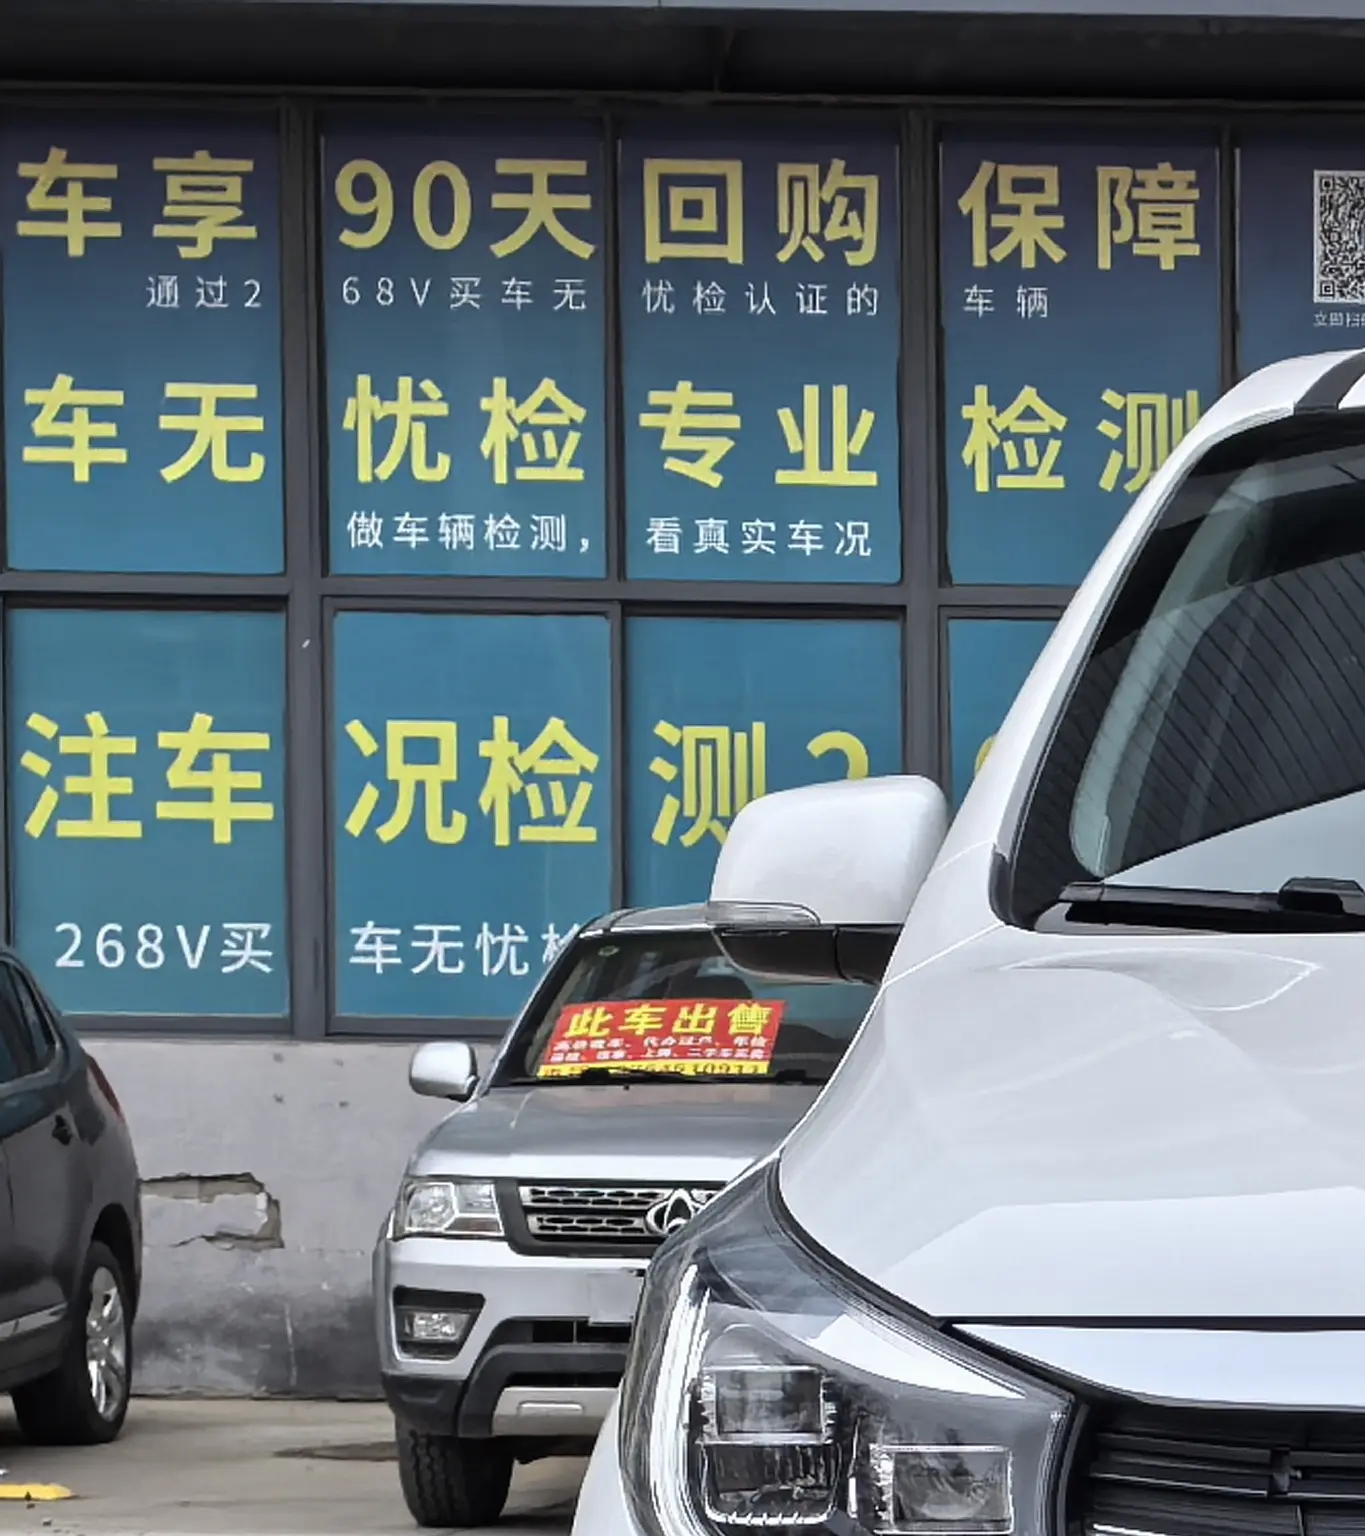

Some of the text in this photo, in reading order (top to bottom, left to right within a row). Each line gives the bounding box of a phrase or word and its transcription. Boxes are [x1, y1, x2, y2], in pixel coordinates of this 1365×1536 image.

[16, 145, 1200, 270] 车享 90天 回购 保障
[145, 274, 1047, 318] 通过2 68V买车无 忧检认证的 车辆
[22, 374, 1199, 493] 车无 忧检 专业 检测
[645, 516, 871, 556] 看真实车况
[20, 711, 274, 844] 注车
[345, 716, 598, 847] 况检
[54, 921, 272, 972] 268V买
[563, 1003, 772, 1038] 此车出售
